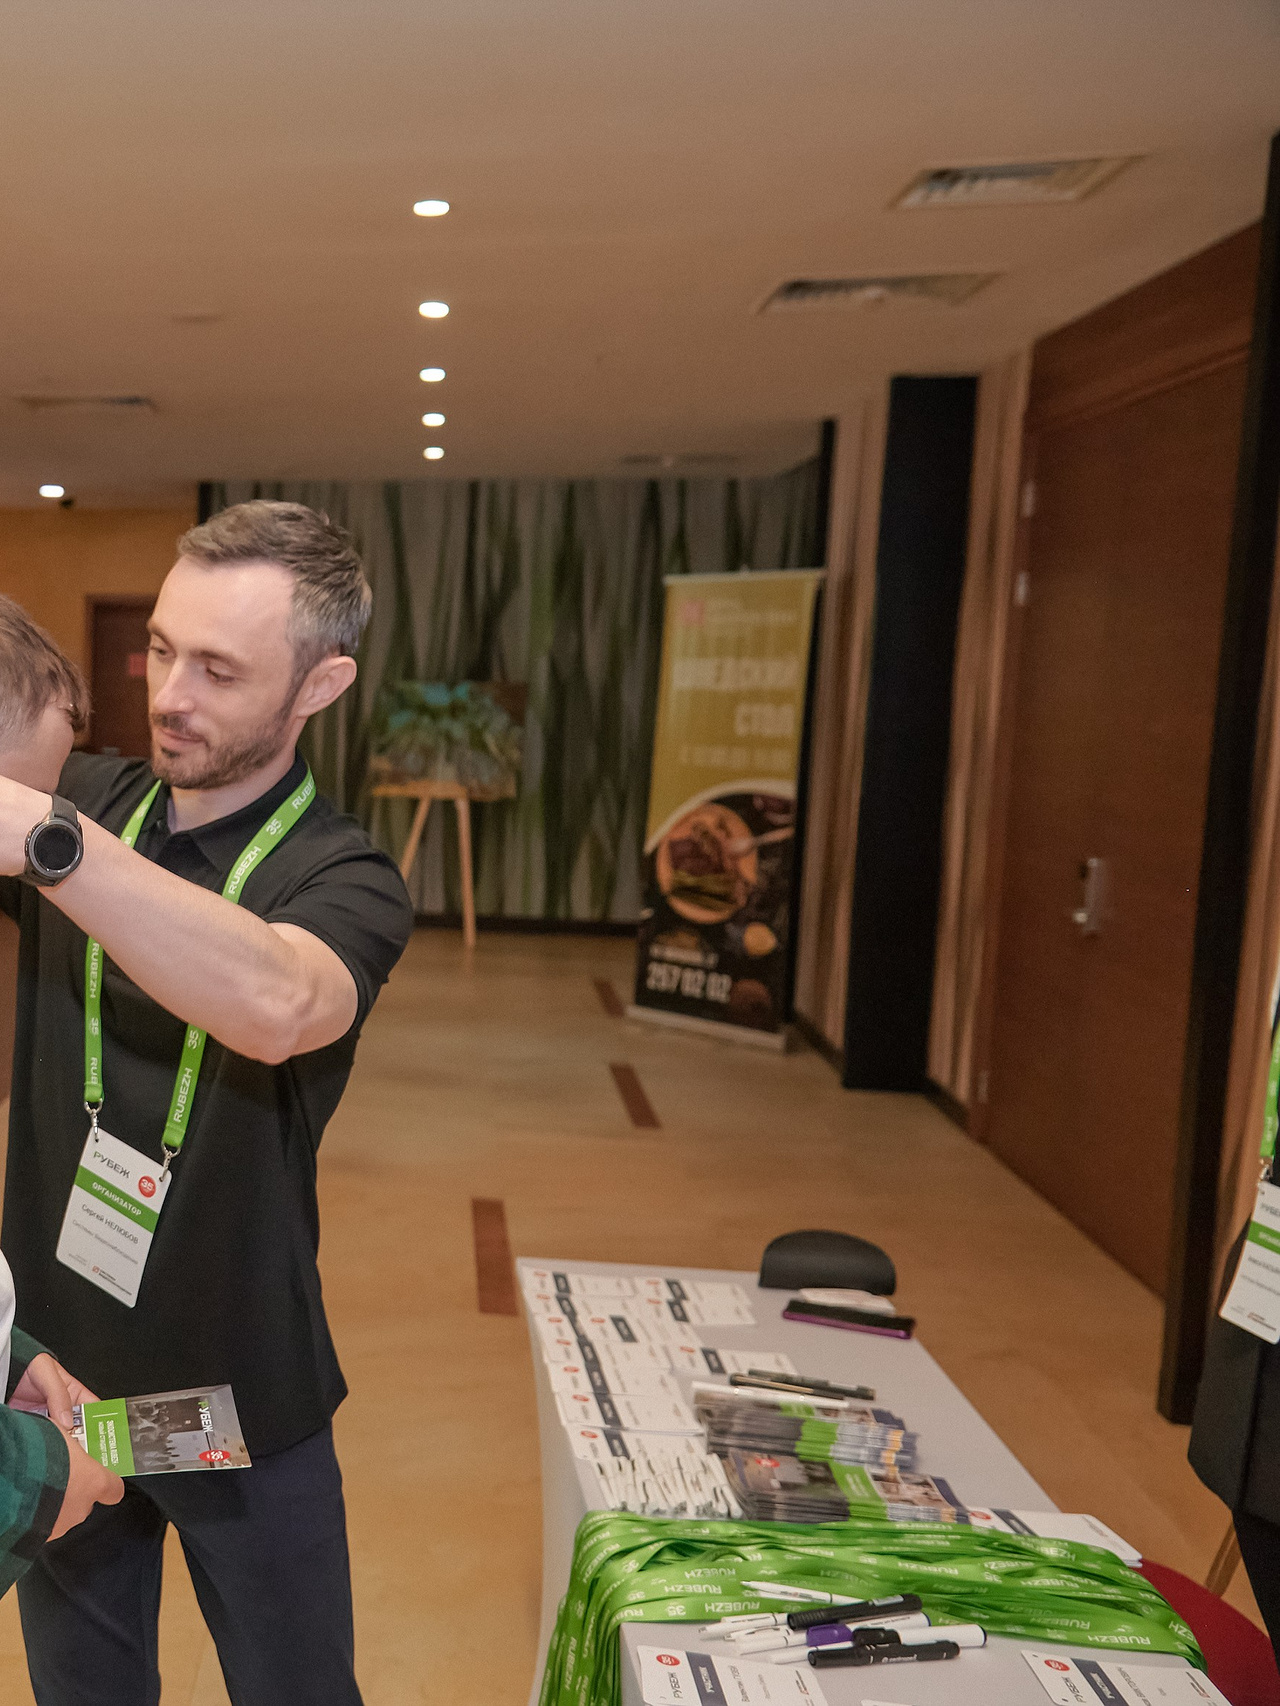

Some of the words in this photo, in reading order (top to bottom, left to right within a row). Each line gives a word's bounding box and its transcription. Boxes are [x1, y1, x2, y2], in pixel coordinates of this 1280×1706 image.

[266, 818, 283, 836] 35
[228, 845, 262, 894] RUBEZH
[89, 942, 100, 999] RUBEZH
[187, 1029, 199, 1050] 35
[173, 1067, 193, 1122] RUBEZH
[93, 1151, 131, 1179] РУБЕЖ
[140, 1178, 153, 1191] 35
[92, 1181, 142, 1217] ОРГАНИЗАТОР
[198, 1400, 213, 1433] РУБЕЖ
[684, 1567, 736, 1579] RUBEZH
[898, 1562, 959, 1575] RUBEZH
[664, 1584, 722, 1594] RUBEZH
[1021, 1578, 1079, 1588] RUBEZH
[666, 1605, 687, 1616] 35
[705, 1602, 761, 1613] RUBEZH
[1088, 1635, 1151, 1645] RUBEZH
[669, 1672, 683, 1699] РУБЕЖ
[1062, 1676, 1086, 1704] РУБЕЖ
